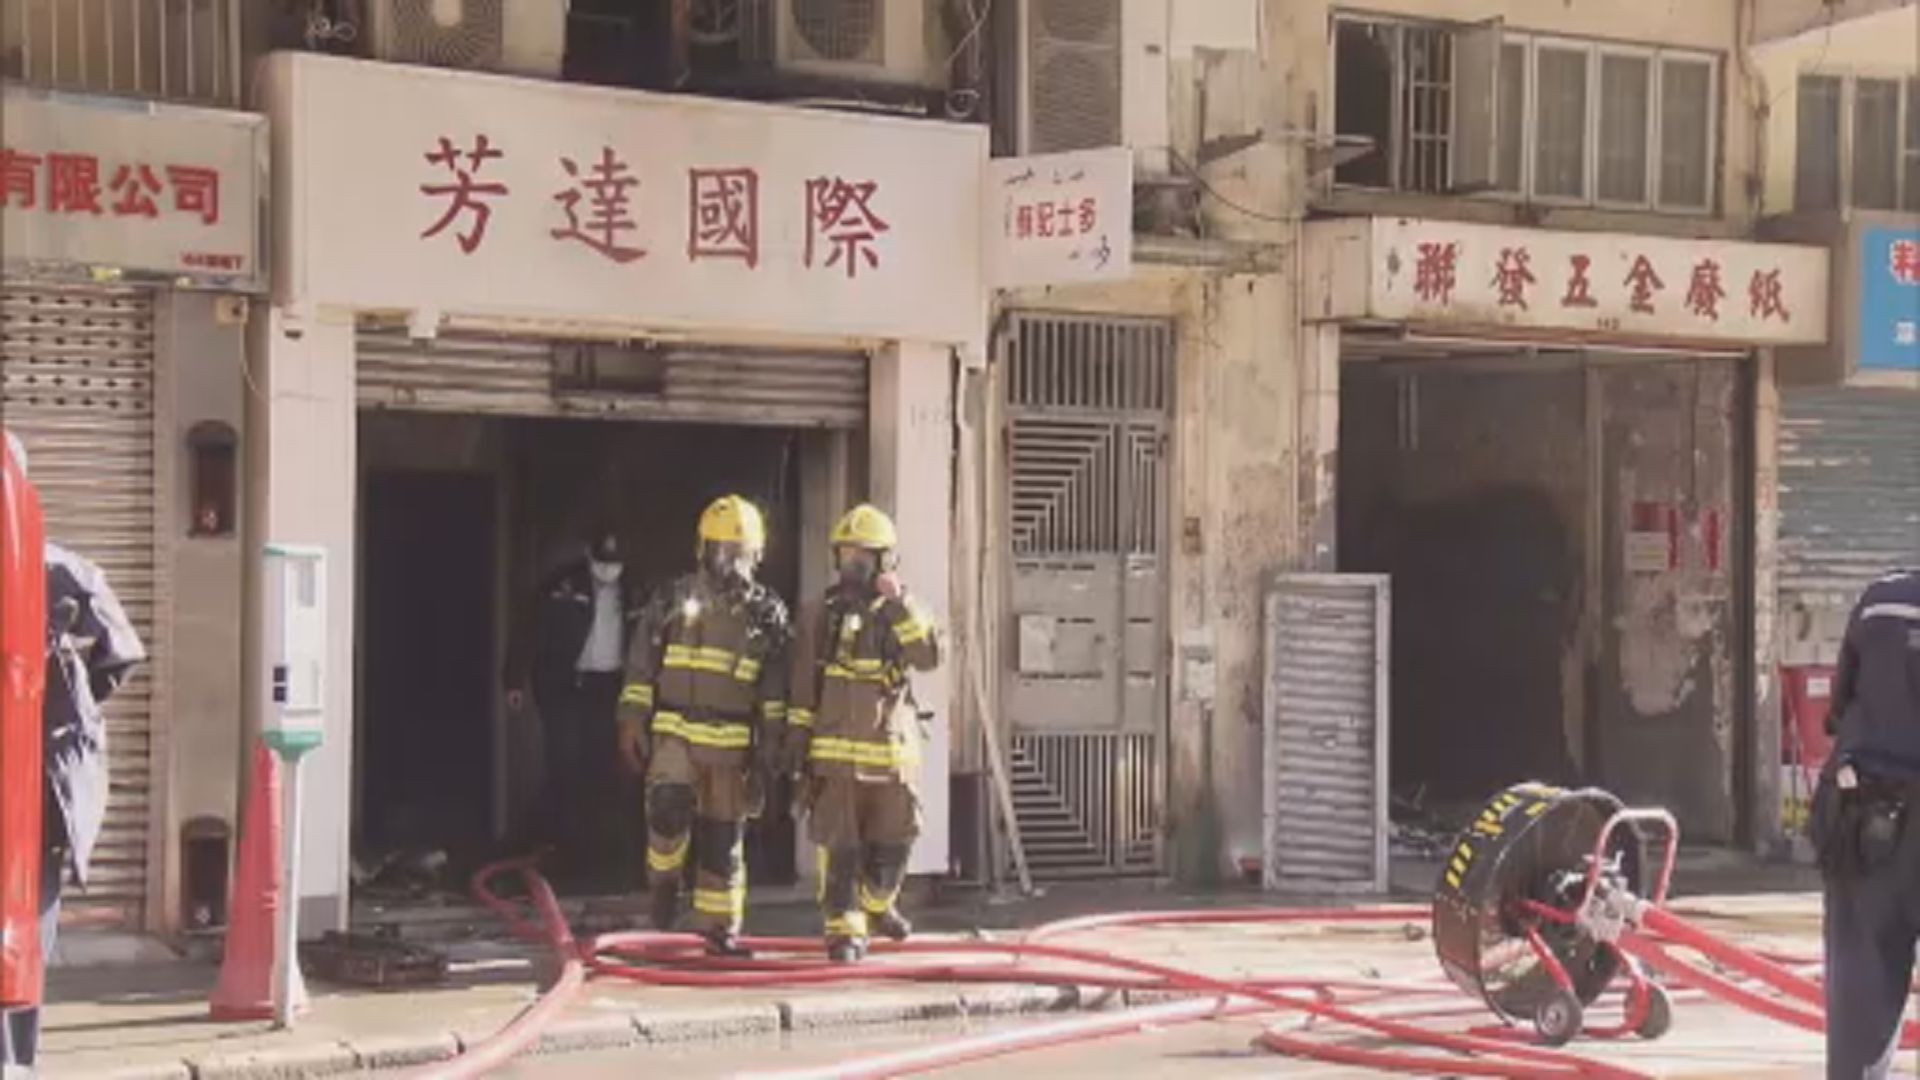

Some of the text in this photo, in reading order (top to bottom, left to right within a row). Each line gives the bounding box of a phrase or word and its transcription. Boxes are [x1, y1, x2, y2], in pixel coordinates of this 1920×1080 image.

[0, 148, 220, 226] 有限公司
[419, 134, 890, 278] 芳達國際
[1413, 241, 1791, 324] 聯發五金廢紙
